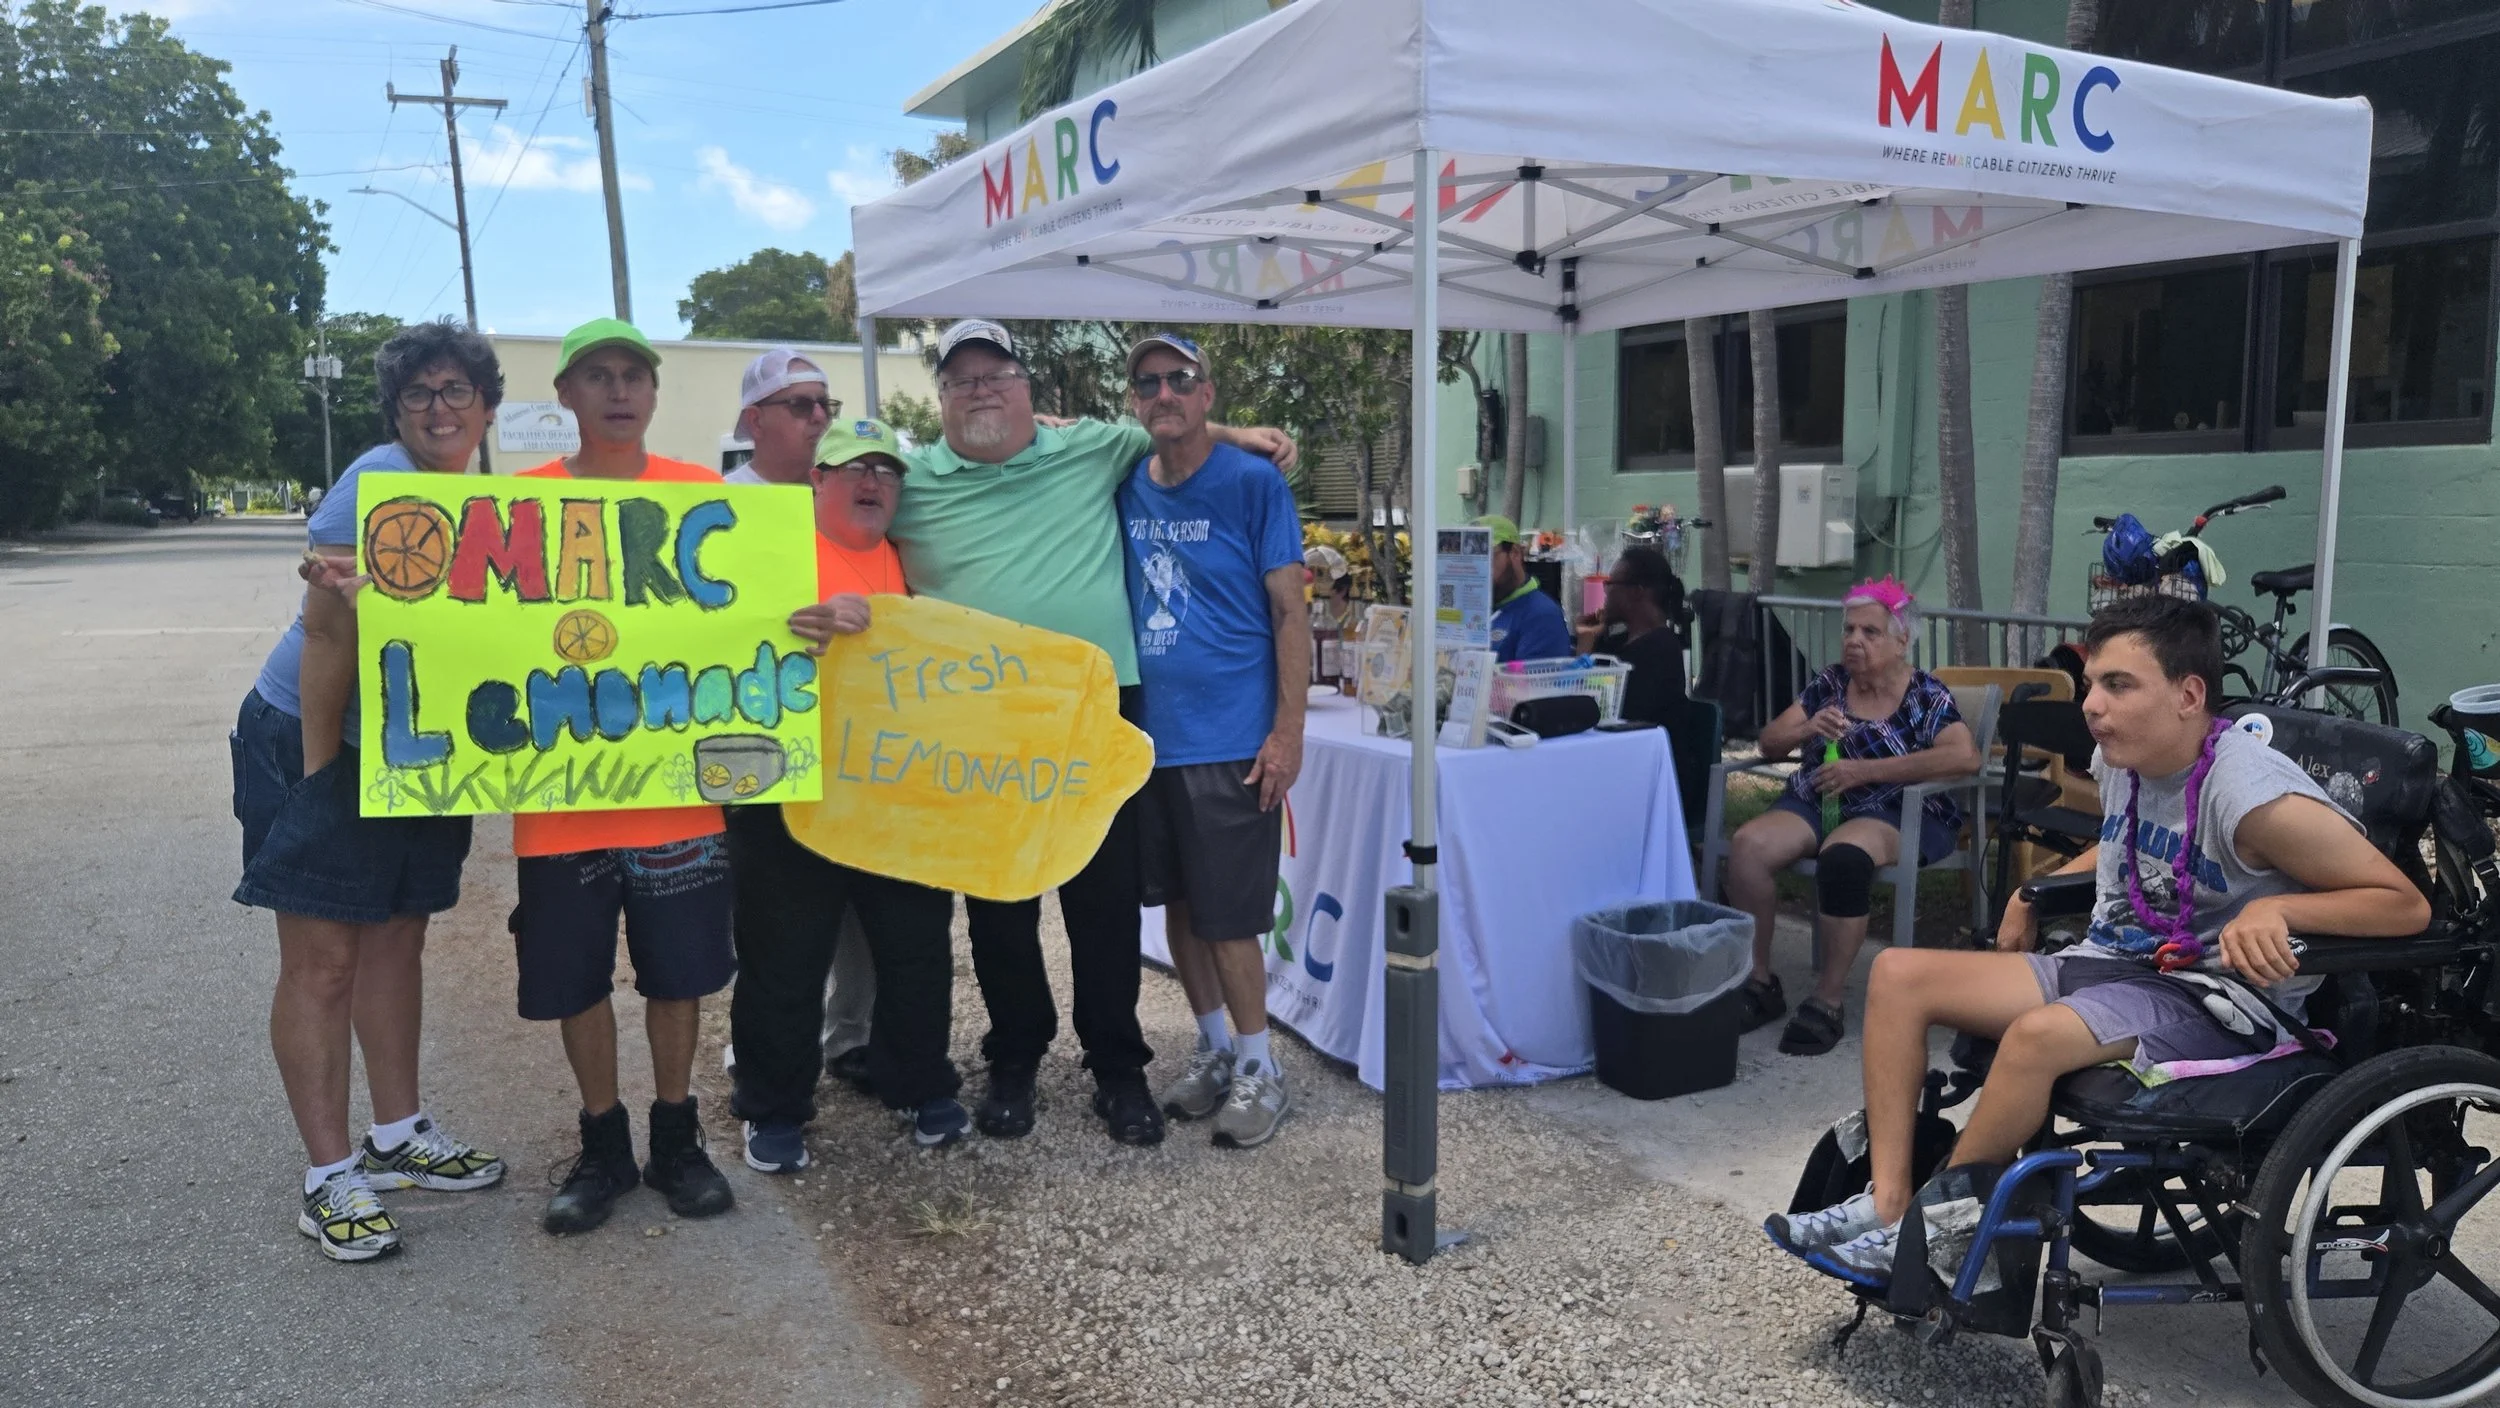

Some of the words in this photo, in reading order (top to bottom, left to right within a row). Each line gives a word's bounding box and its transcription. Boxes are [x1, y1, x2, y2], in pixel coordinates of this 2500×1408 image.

[1878, 32, 2121, 153] MARC
[982, 99, 1120, 229] MARC
[1882, 144, 1927, 164] WHERE
[1931, 152, 2013, 173] REMARCABLE
[2017, 159, 2073, 178] CITIZENS
[2076, 166, 2117, 184] THRIVE
[1014, 218, 1056, 243] REMRCABLE
[1057, 206, 1092, 231] CITIZENS
[1092, 198, 1124, 219] THRIVE
[548, 431, 577, 441] DEPART
[1166, 519, 1211, 543] SEASON
[1152, 629, 1180, 646] WEST
[869, 643, 1028, 712] Fresh
[838, 719, 1090, 804] LEMONADE
[2296, 754, 2331, 779] Alex
